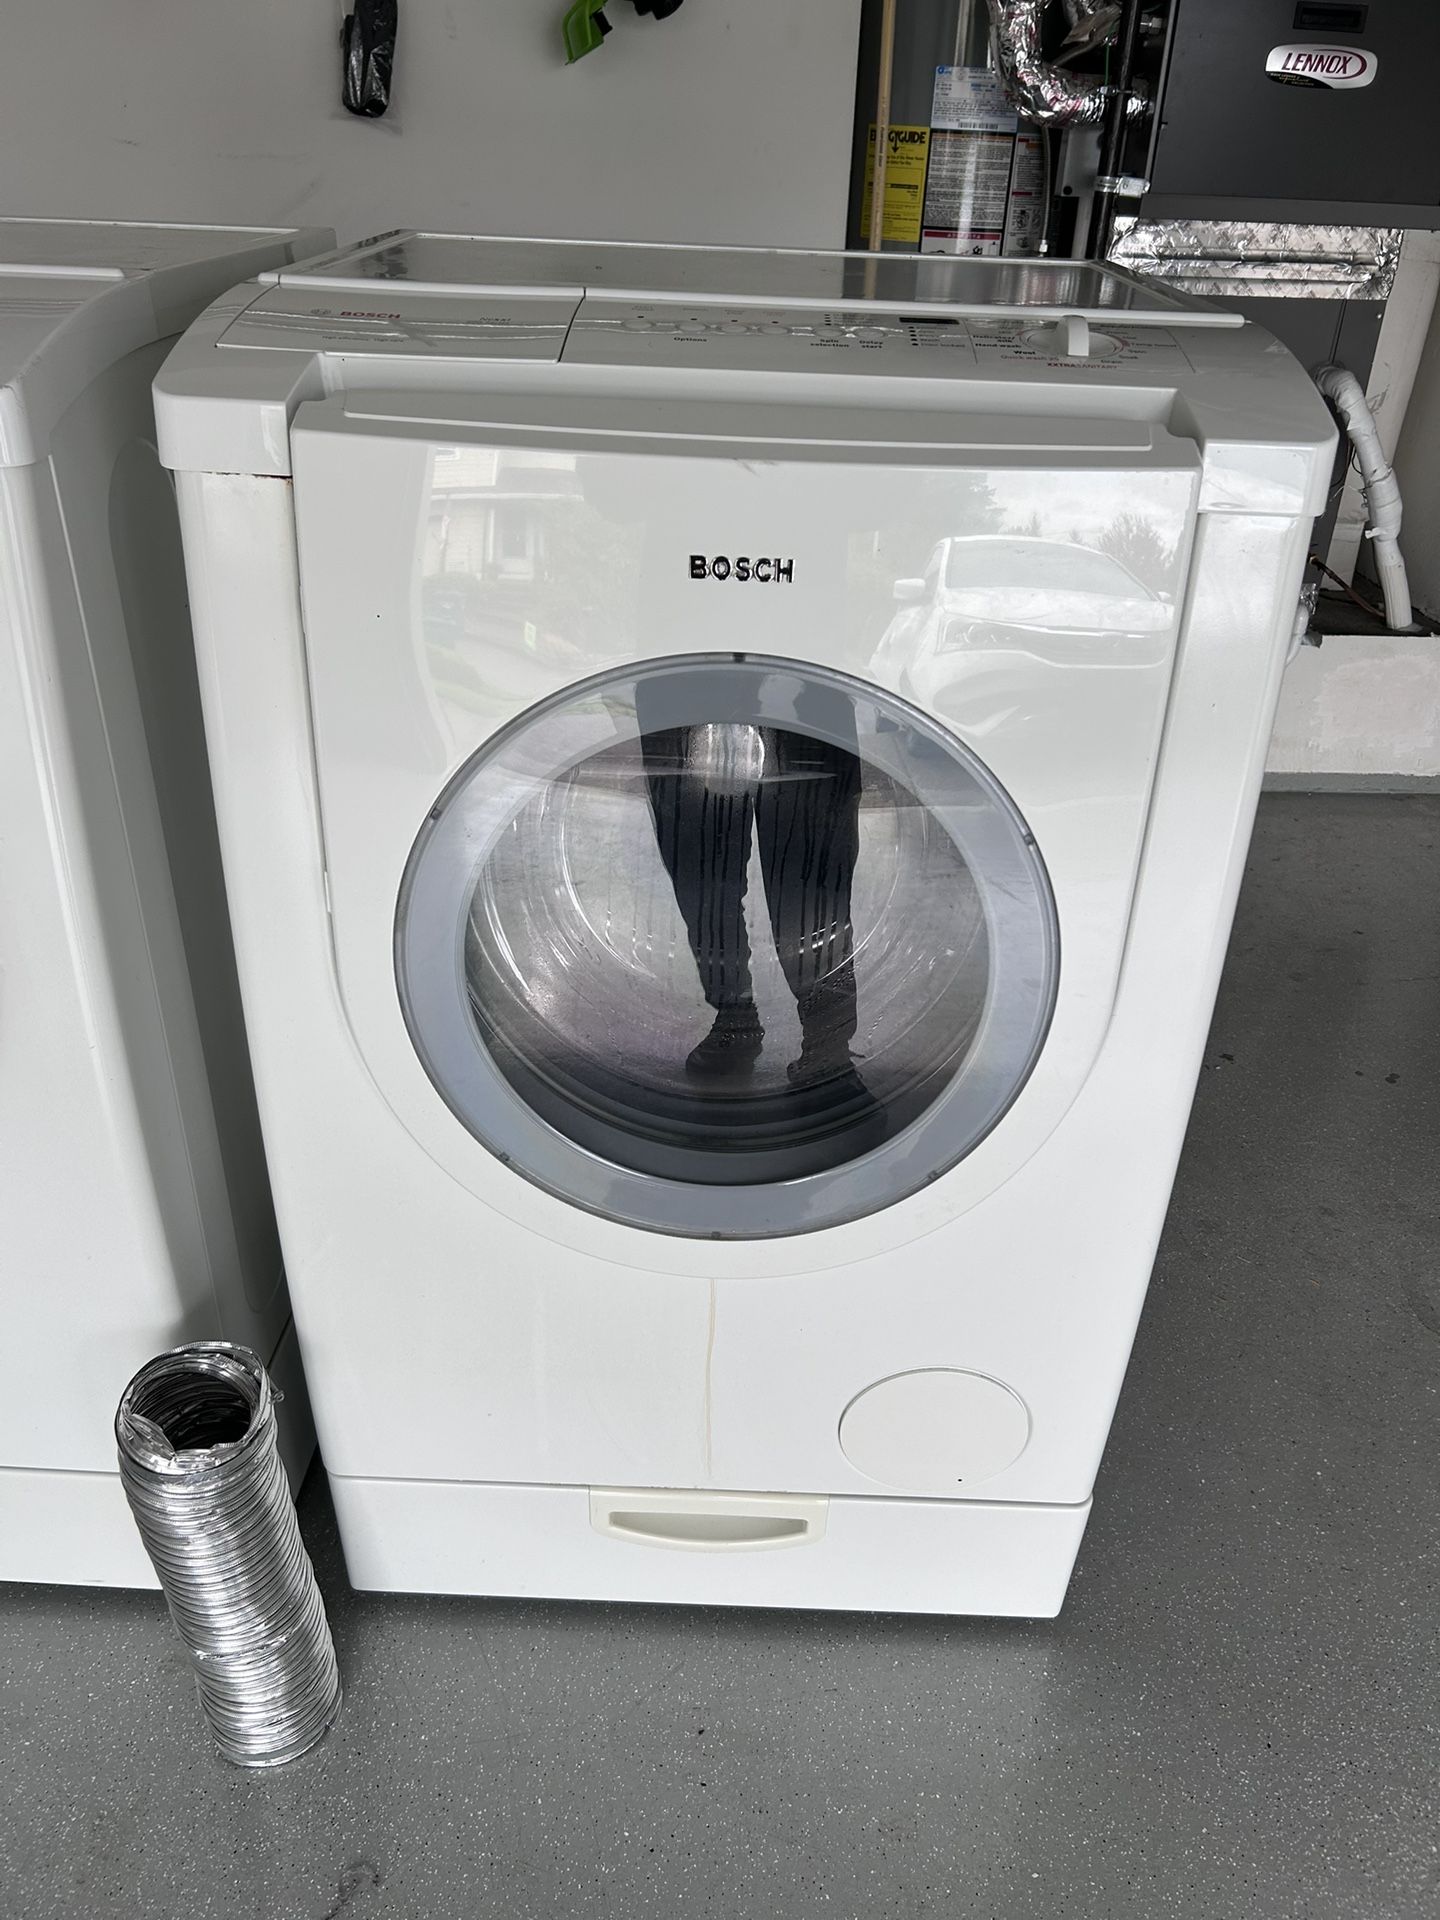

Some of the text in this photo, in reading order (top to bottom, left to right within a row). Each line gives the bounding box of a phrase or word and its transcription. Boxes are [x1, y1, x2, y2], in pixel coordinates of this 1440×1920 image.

[1281, 52, 1352, 74] LENNOX
[340, 311, 401, 319] BOSCH
[688, 554, 795, 583] BOSCH
